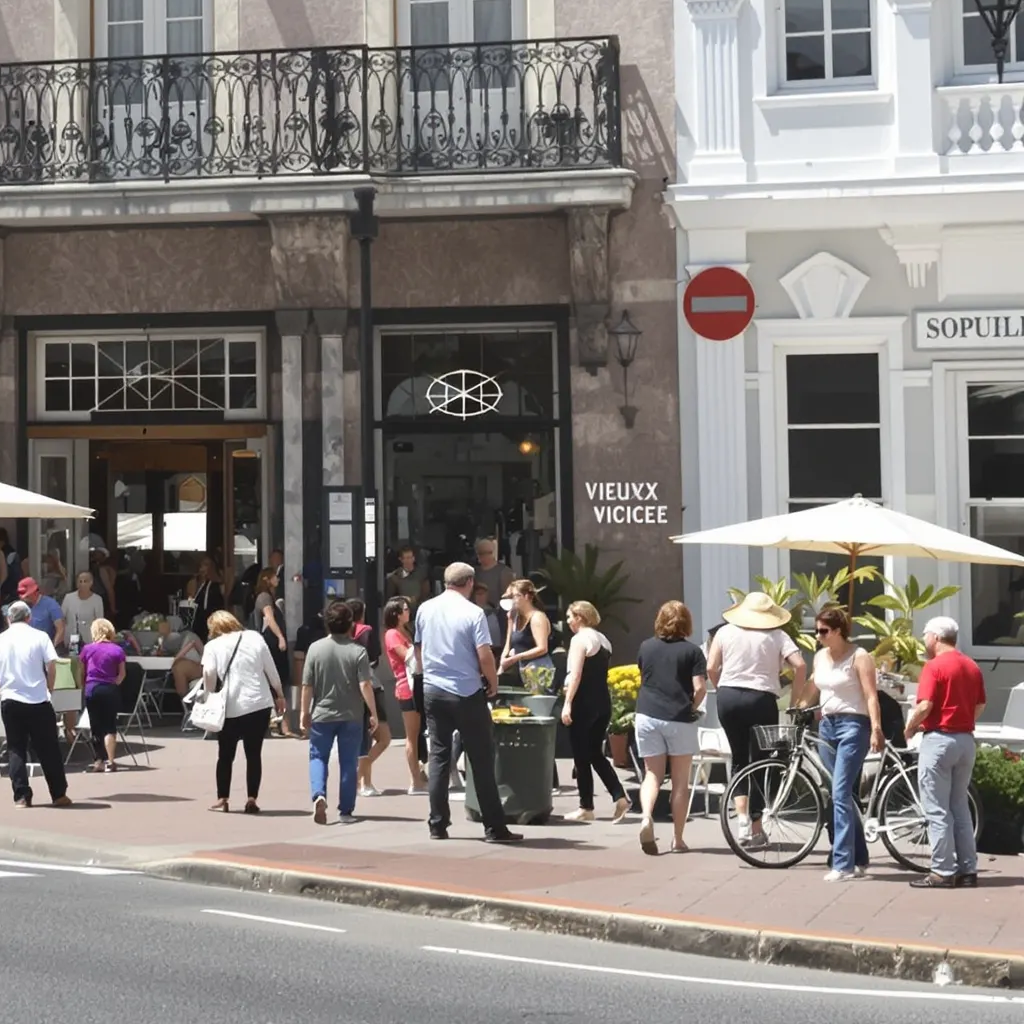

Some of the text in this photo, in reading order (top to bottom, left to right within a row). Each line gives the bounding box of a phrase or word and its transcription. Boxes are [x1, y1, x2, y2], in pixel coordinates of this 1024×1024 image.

[926, 316, 1024, 339] SOPUIL
[585, 482, 659, 501] VIEUXX
[593, 505, 668, 524] VICICEE
